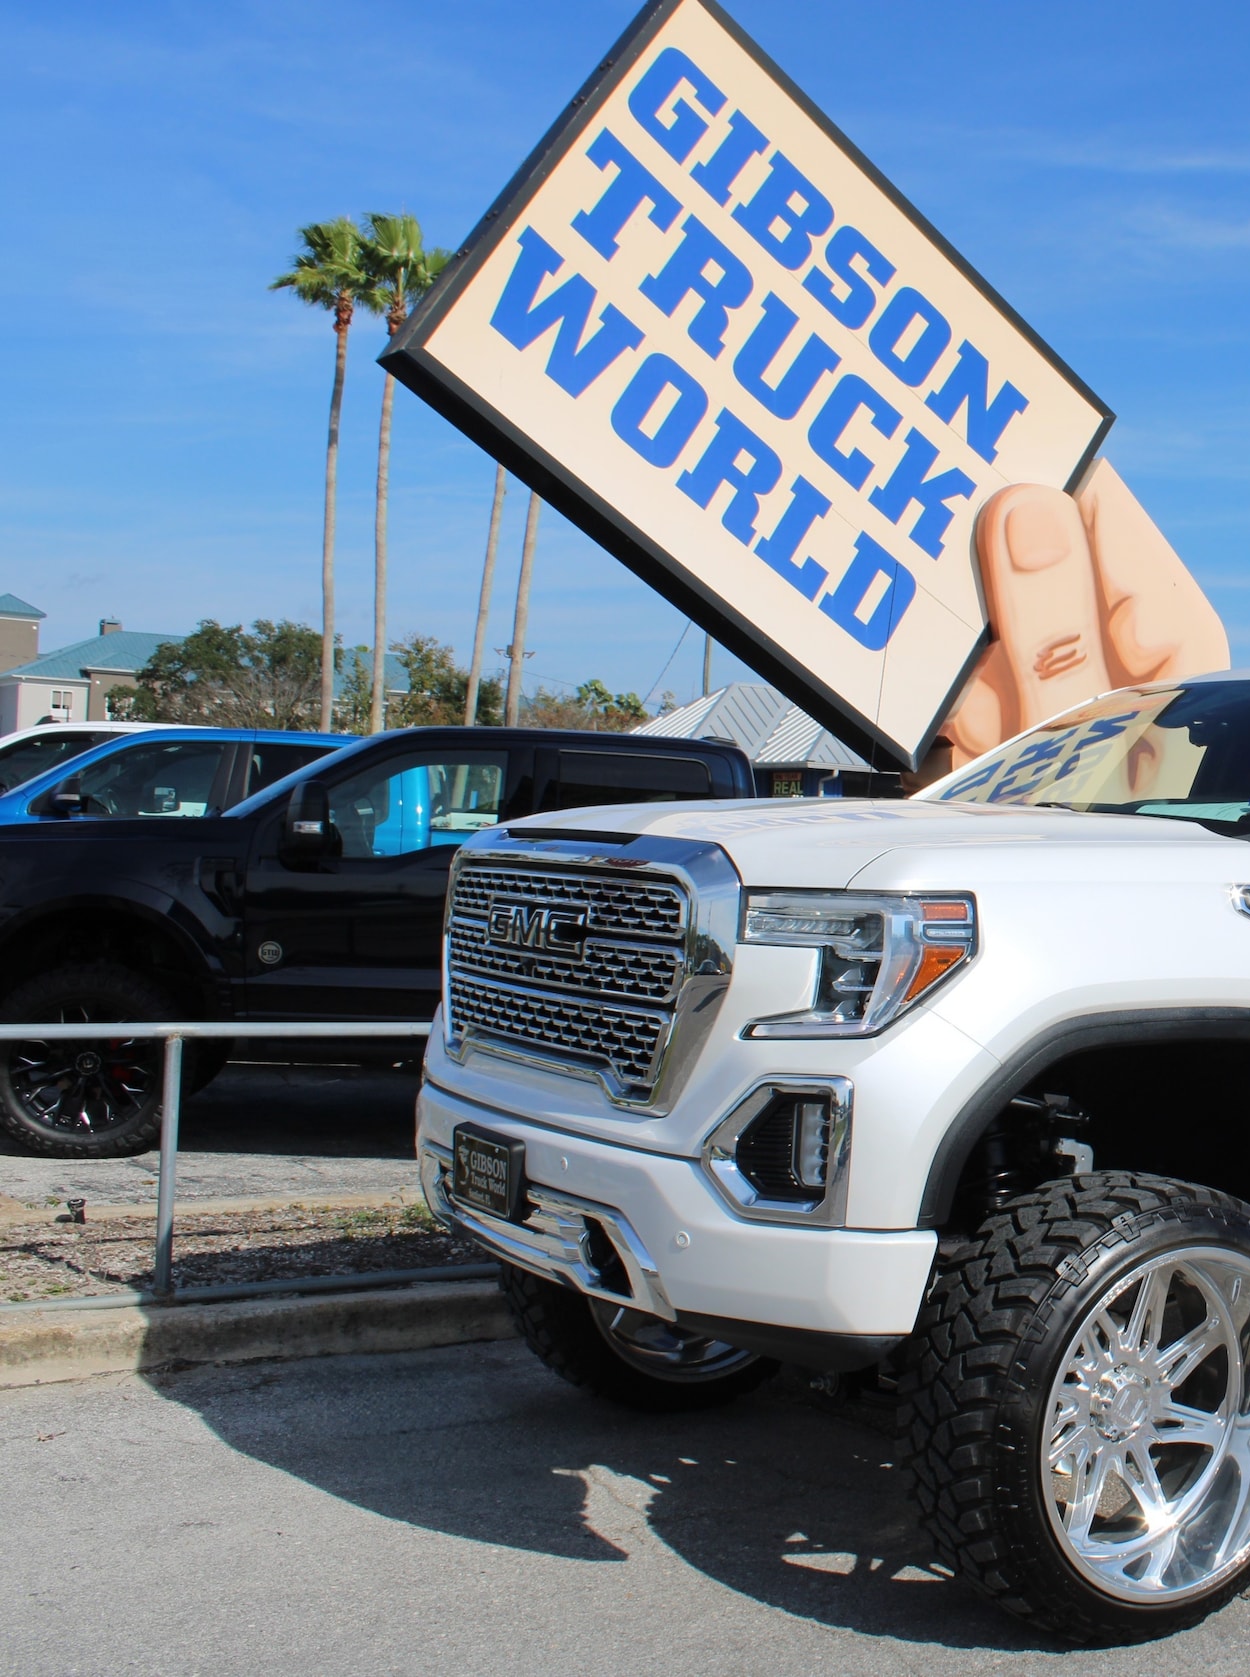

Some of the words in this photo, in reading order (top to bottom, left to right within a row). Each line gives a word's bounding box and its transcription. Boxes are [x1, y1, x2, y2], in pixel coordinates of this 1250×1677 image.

[628, 47, 1030, 466] GIBSON
[570, 127, 978, 562] TRUCK
[489, 225, 917, 652] WORLD
[773, 781, 804, 795] REAL
[488, 903, 586, 957] GMC
[470, 1151, 507, 1181] GIBSON
[470, 1171, 488, 1189] Truck
[488, 1177, 506, 1197] World
